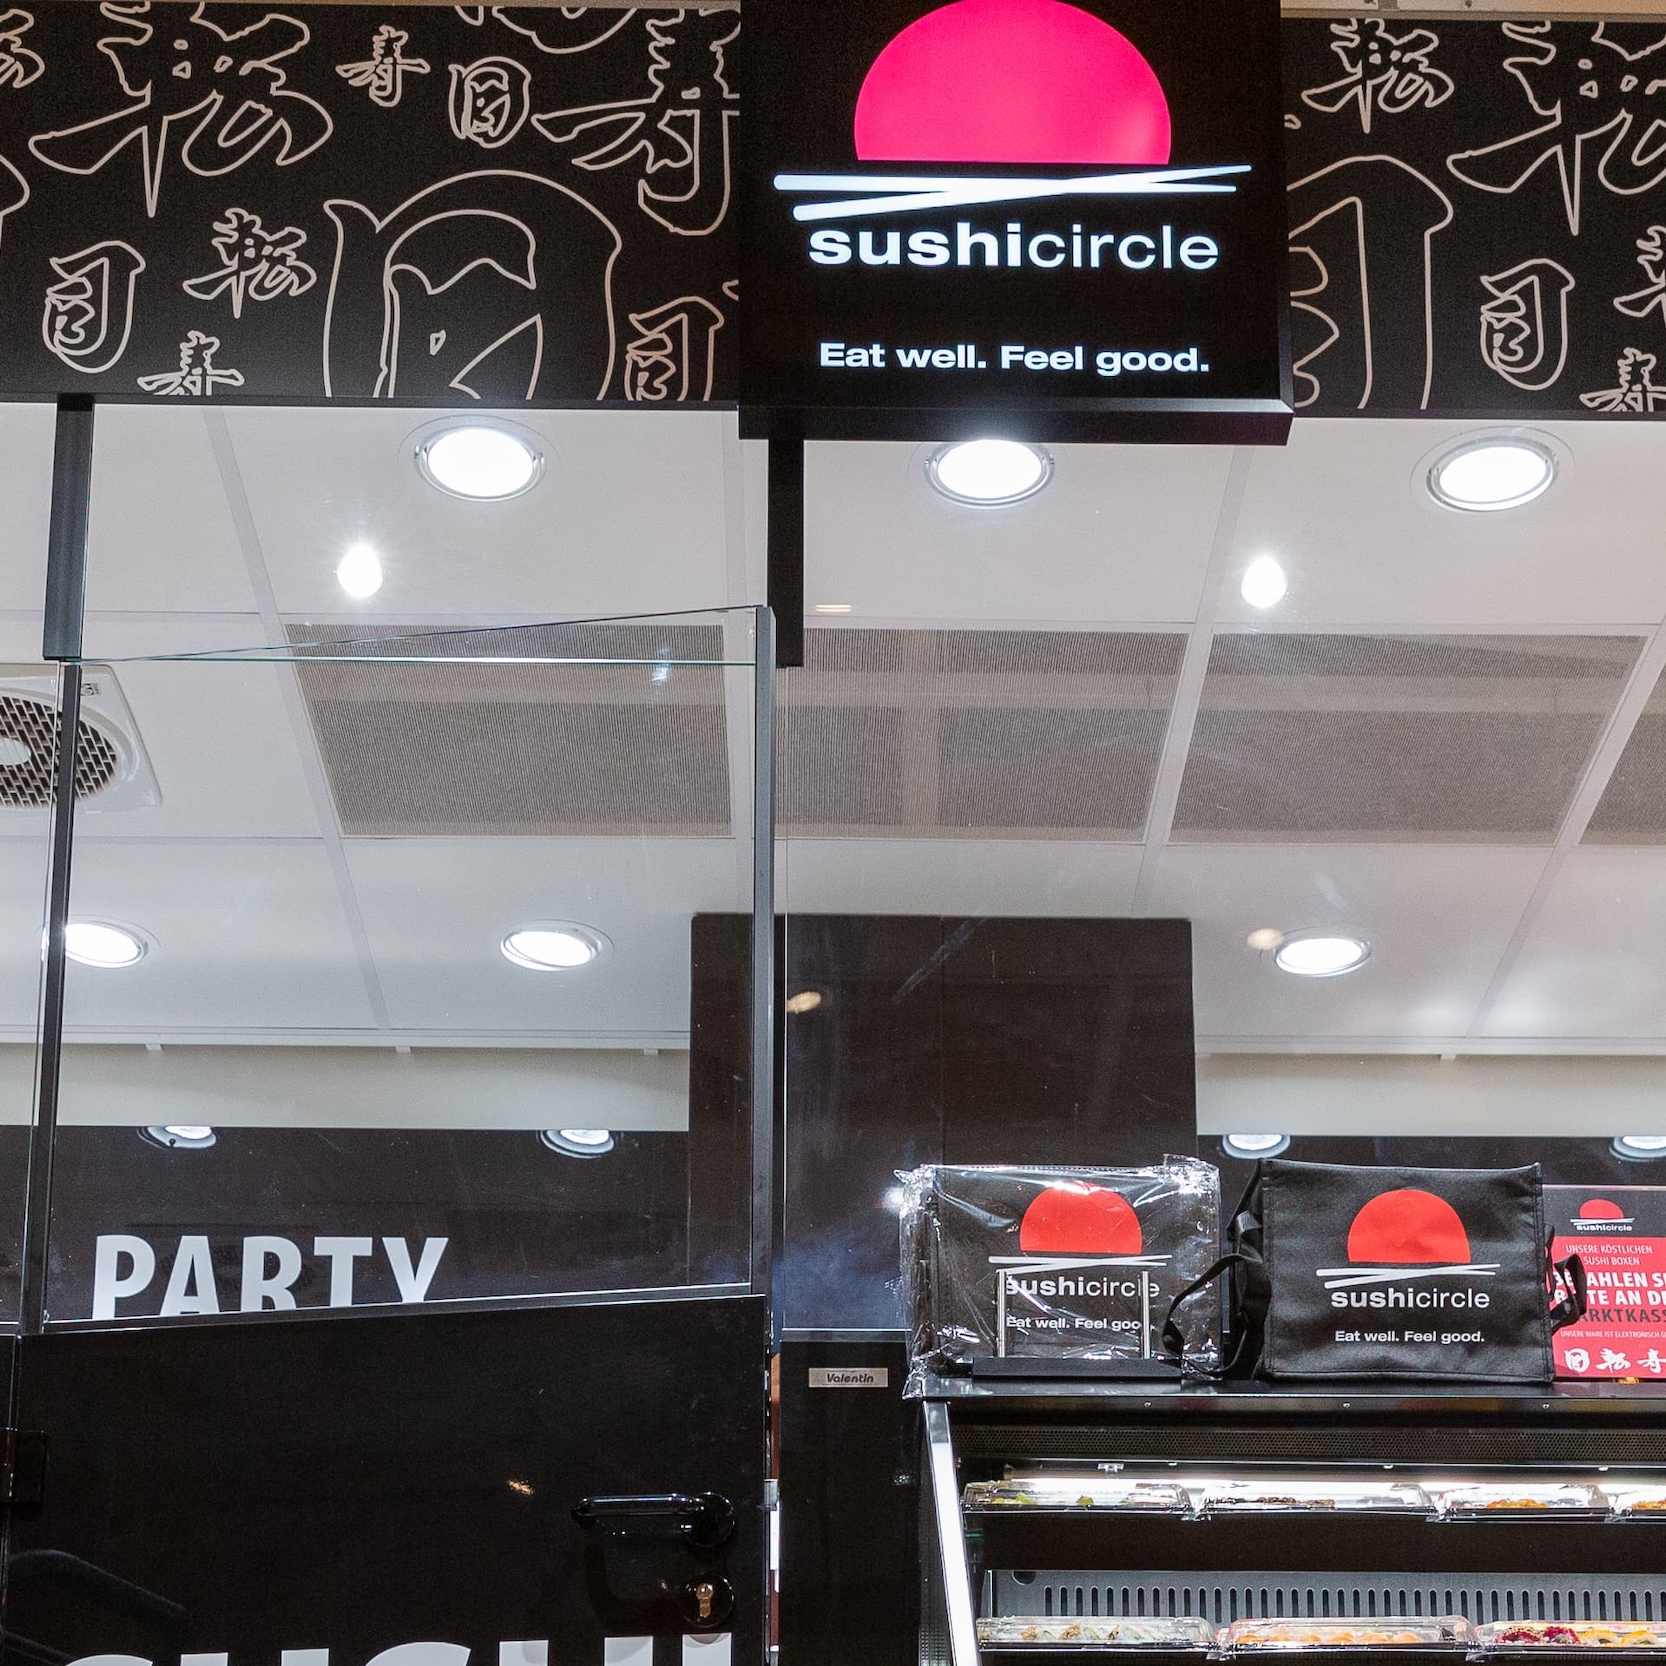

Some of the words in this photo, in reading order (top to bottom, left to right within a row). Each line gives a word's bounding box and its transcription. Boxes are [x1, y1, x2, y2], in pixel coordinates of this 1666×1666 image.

[809, 221, 1220, 271] sushicircle
[819, 341, 886, 369] Eat
[896, 342, 987, 369] well.
[1001, 344, 1084, 371] Feel
[1097, 346, 1211, 377] good.
[1565, 1244, 1599, 1254] UNSERE
[1600, 1244, 1653, 1254] KÖSTLICHEN
[1583, 1256, 1610, 1265] SUSHI
[1611, 1256, 1640, 1266] BOXEN
[91, 1234, 449, 1321] PARTY
[1330, 1286, 1491, 1309] sushicircle
[1614, 1290, 1642, 1305] AN
[1072, 1316, 1104, 1328] Feel
[1335, 1330, 1361, 1342] Eat
[1364, 1330, 1400, 1342] well.
[1404, 1330, 1437, 1342] Feel
[1441, 1331, 1485, 1345] good.
[826, 1373, 874, 1384] Valentin
